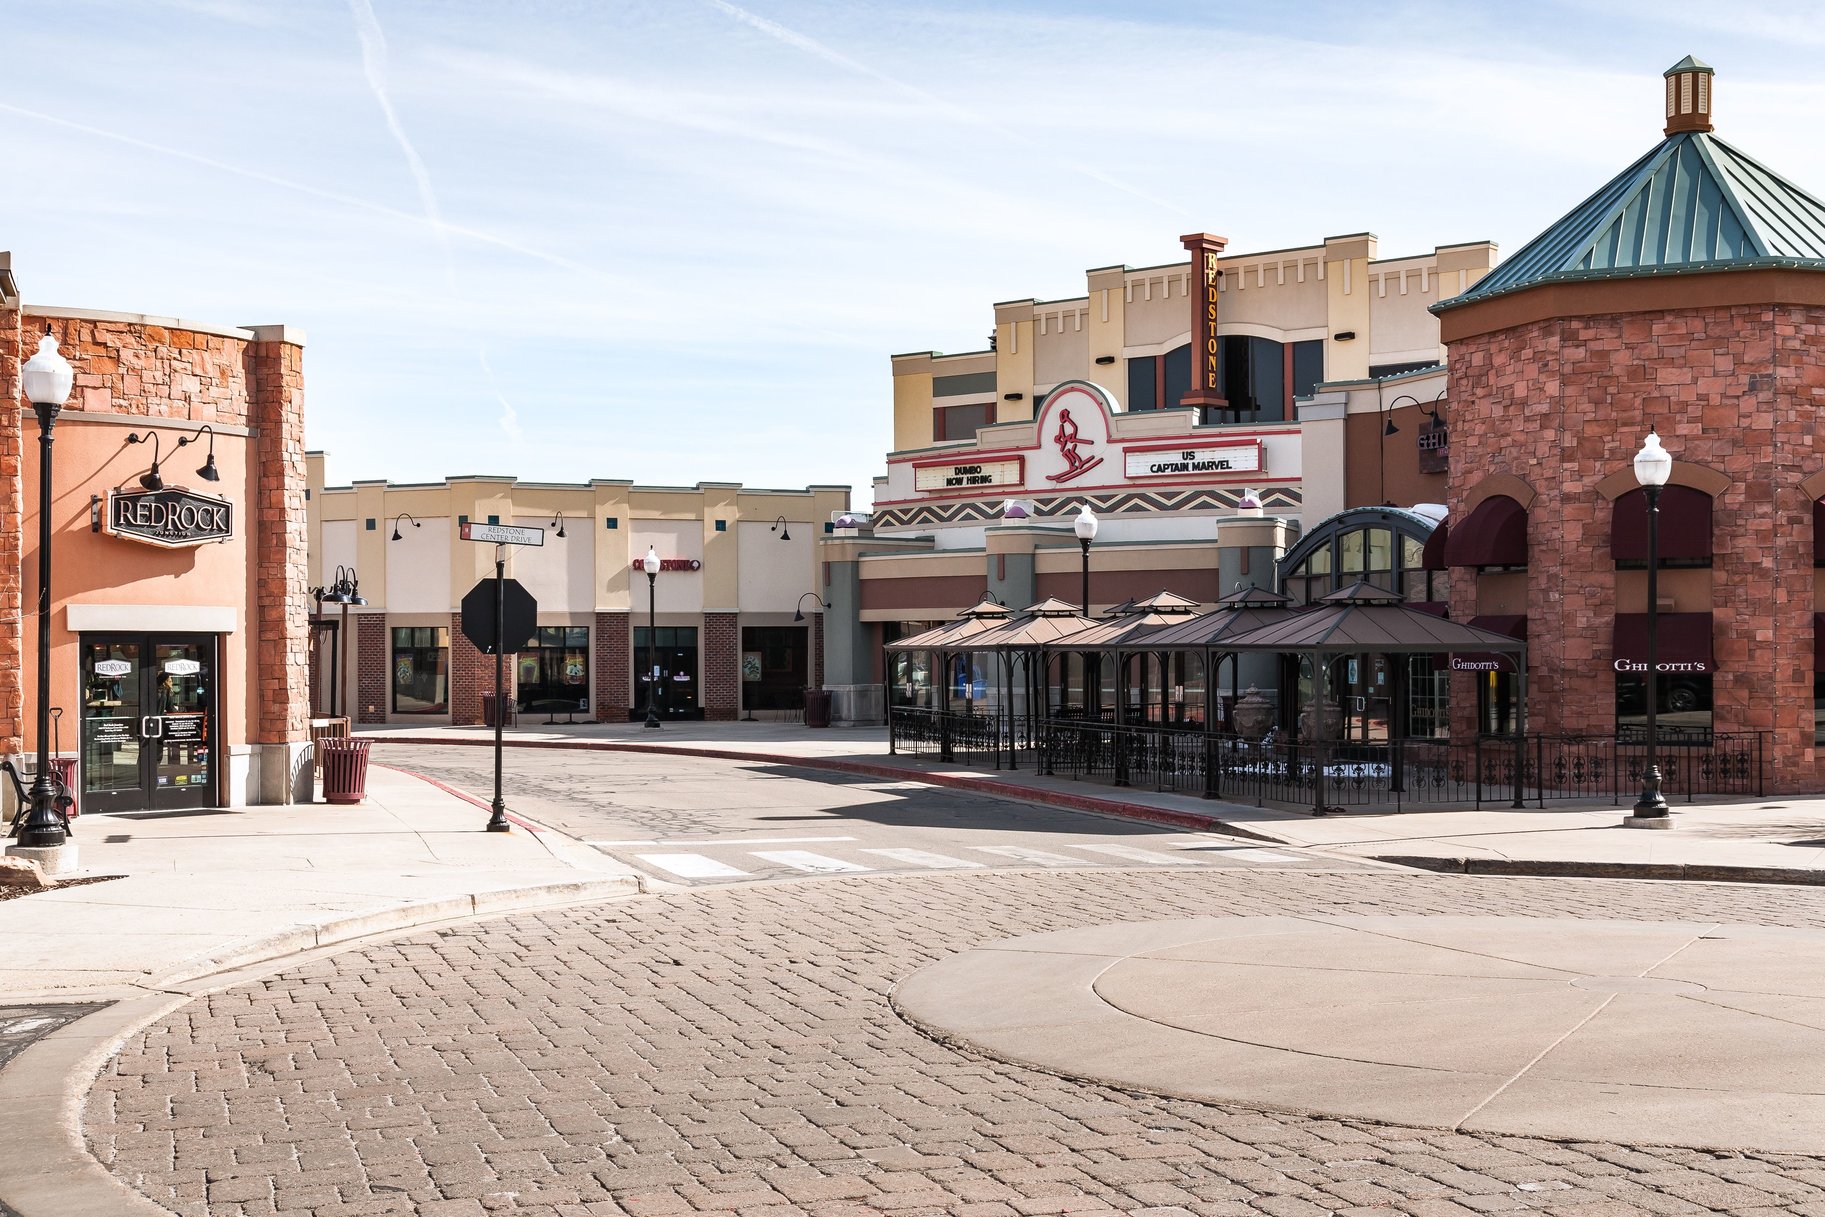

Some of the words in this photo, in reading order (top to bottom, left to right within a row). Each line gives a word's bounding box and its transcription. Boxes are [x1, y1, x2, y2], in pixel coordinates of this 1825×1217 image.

[1208, 252, 1217, 388] REDSTONE
[1182, 451, 1195, 460] US
[954, 465, 982, 476] DUMBO
[1150, 462, 1189, 473] CAPTAIN
[1192, 460, 1232, 471] MARVEL
[946, 477, 964, 486] NOW
[966, 475, 992, 485] HIRING
[118, 500, 227, 531] REDROCK
[488, 526, 525, 535] REDSTONE
[481, 533, 509, 542] CENTER
[510, 535, 532, 543] DRIVE
[97, 663, 129, 672] REDROCK
[167, 662, 199, 672] REDROCK
[1614, 659, 1706, 671] GHIOTTI'S
